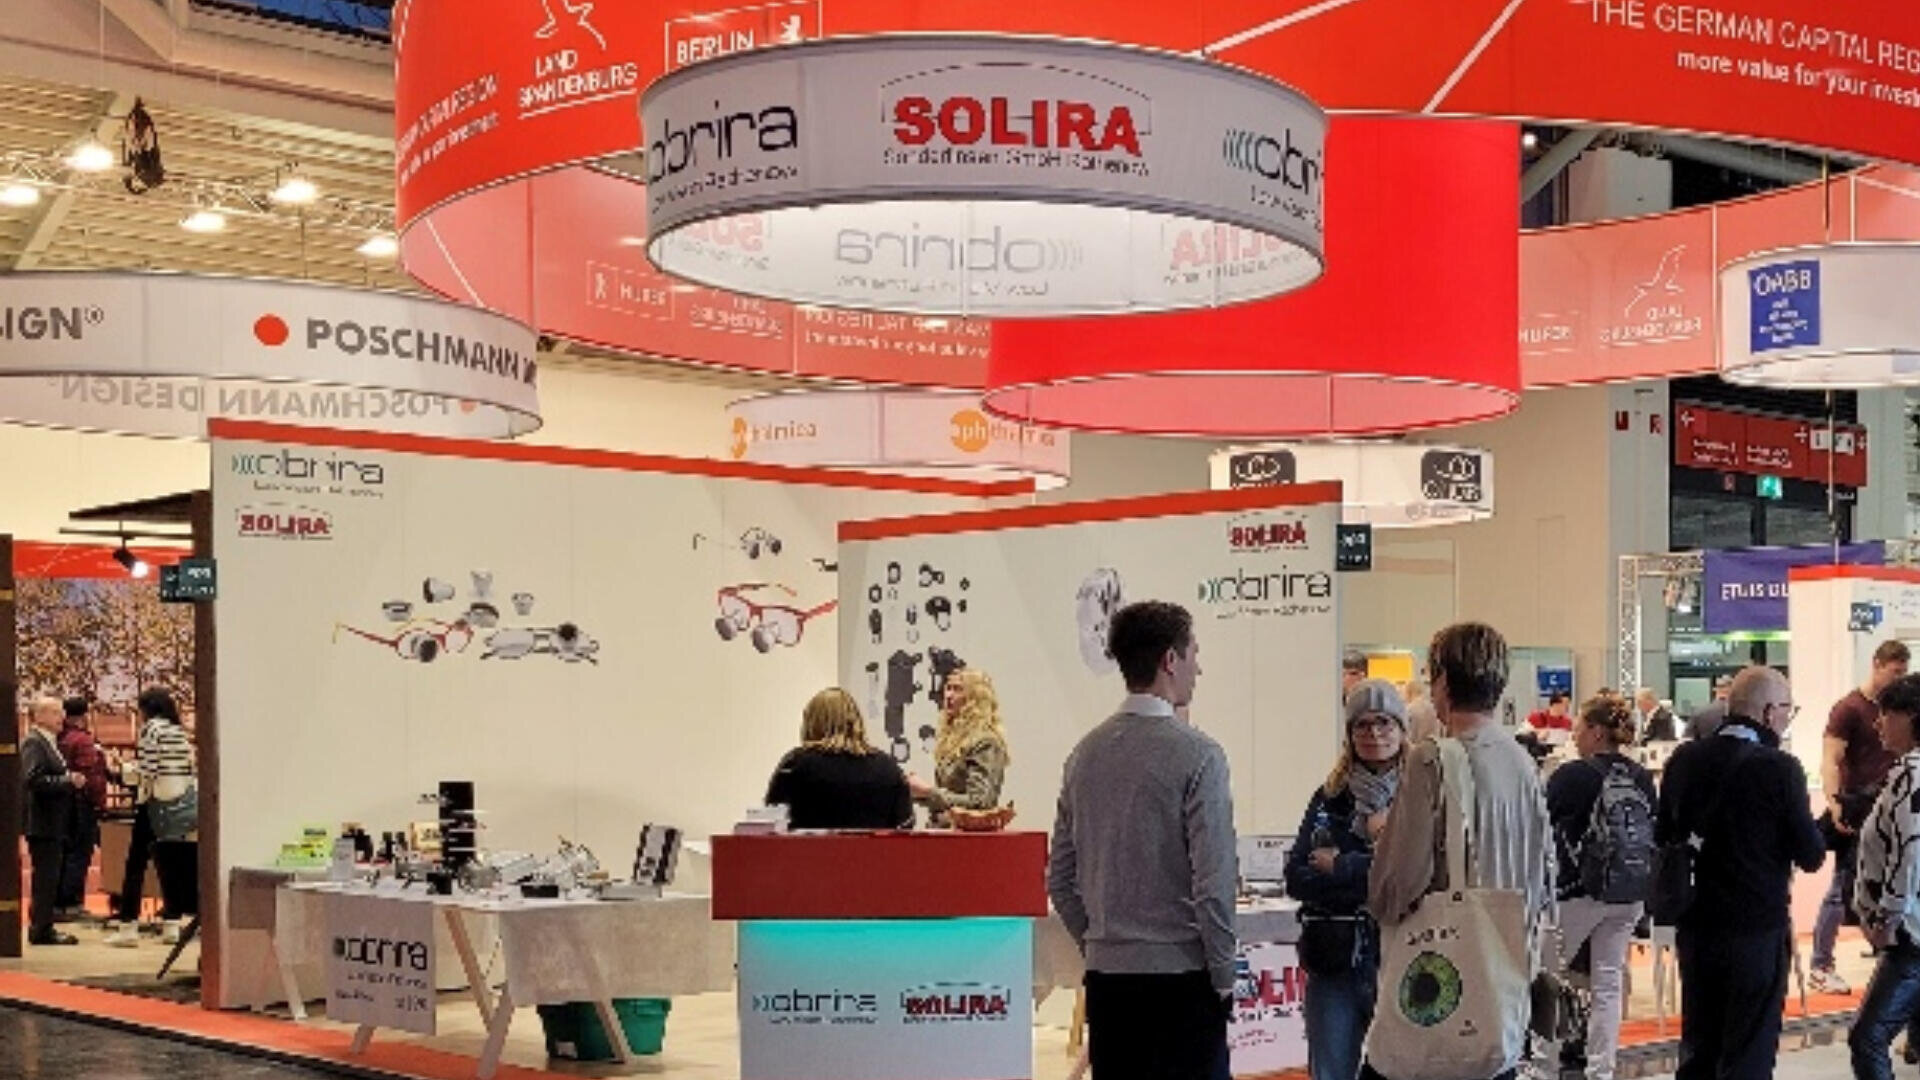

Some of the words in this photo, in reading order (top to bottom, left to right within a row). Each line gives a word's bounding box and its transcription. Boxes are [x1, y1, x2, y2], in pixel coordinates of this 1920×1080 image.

[676, 29, 755, 64] BERLIN
[1590, 0, 1645, 29] THE
[1654, 3, 1773, 45] GERMAN
[1778, 21, 1873, 64] CAPITAL
[535, 49, 578, 79] LAND
[1677, 51, 1733, 73] more
[1738, 57, 1789, 83] value
[1794, 62, 1823, 87] for
[1823, 68, 1867, 95] your
[893, 96, 1143, 157] SOLIRA
[0, 305, 104, 341] IGN®
[306, 317, 519, 381] POSCHMANN
[257, 448, 384, 485] obrira
[239, 513, 331, 536] SOLIRA
[1218, 563, 1332, 600] obrira
